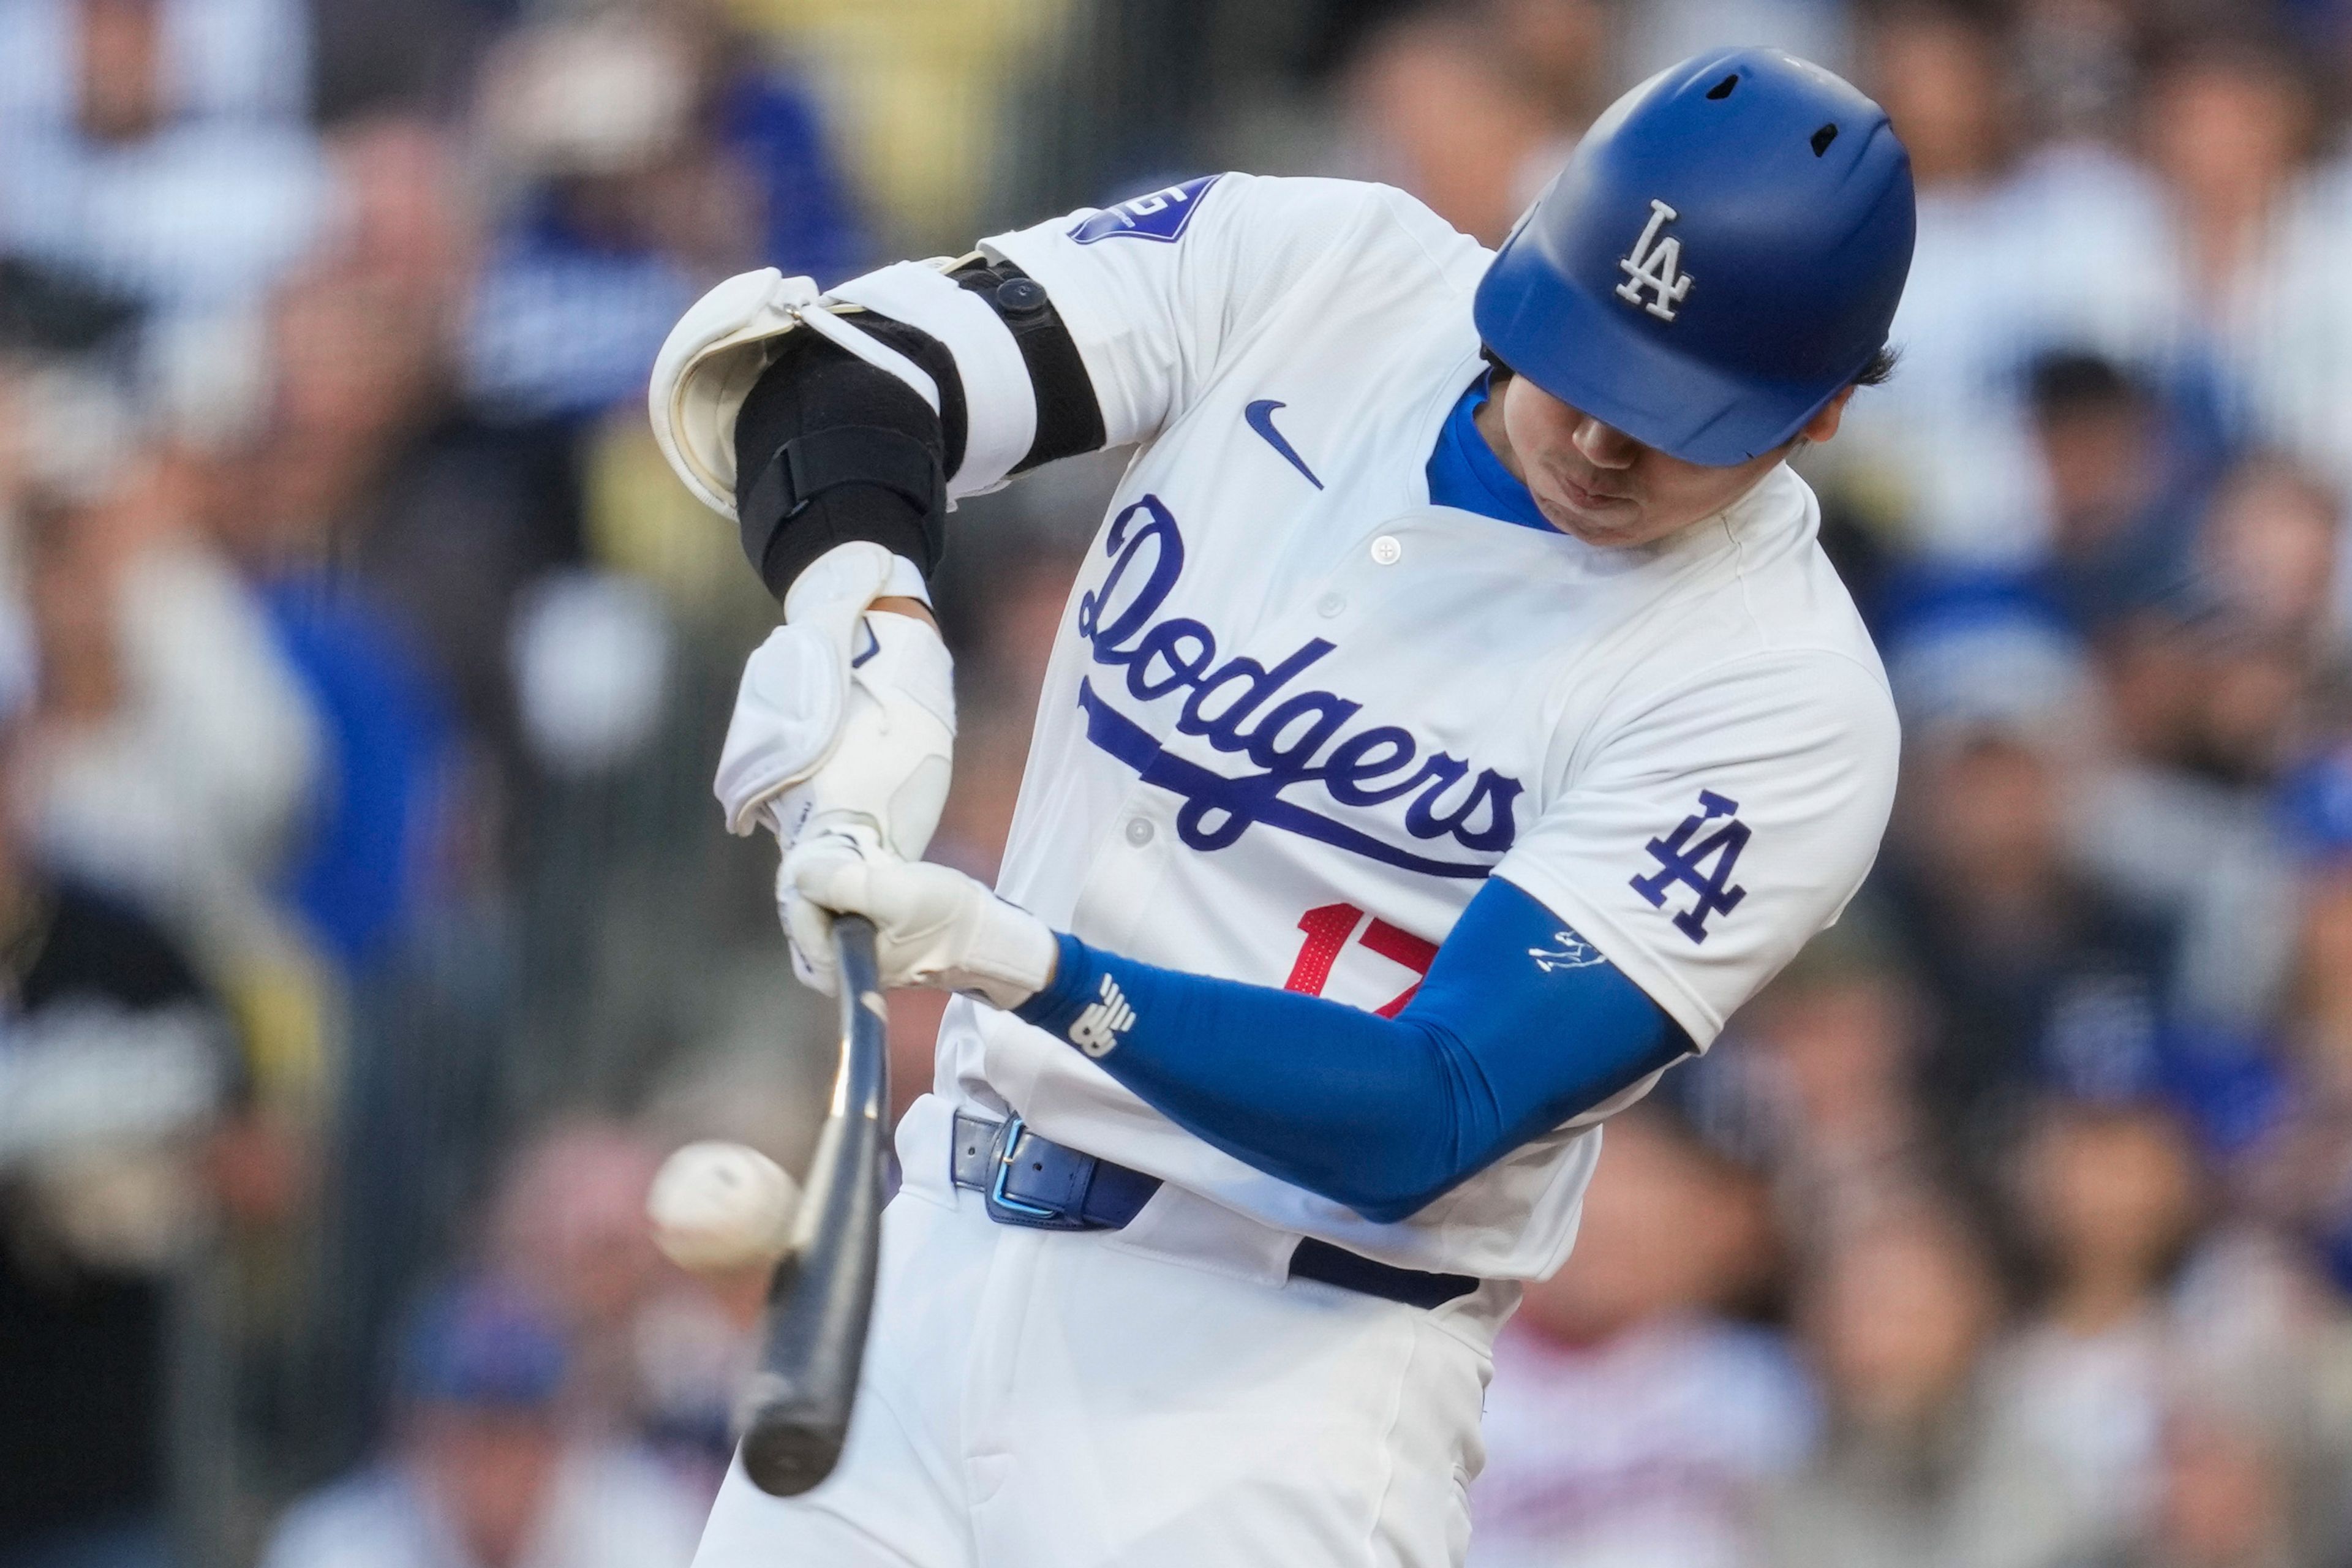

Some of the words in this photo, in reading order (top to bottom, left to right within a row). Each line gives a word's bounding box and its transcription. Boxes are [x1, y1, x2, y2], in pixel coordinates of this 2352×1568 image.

[1616, 198, 1692, 322] LA
[1079, 493, 1525, 853] Dodgers
[1629, 789, 1752, 945] LA
